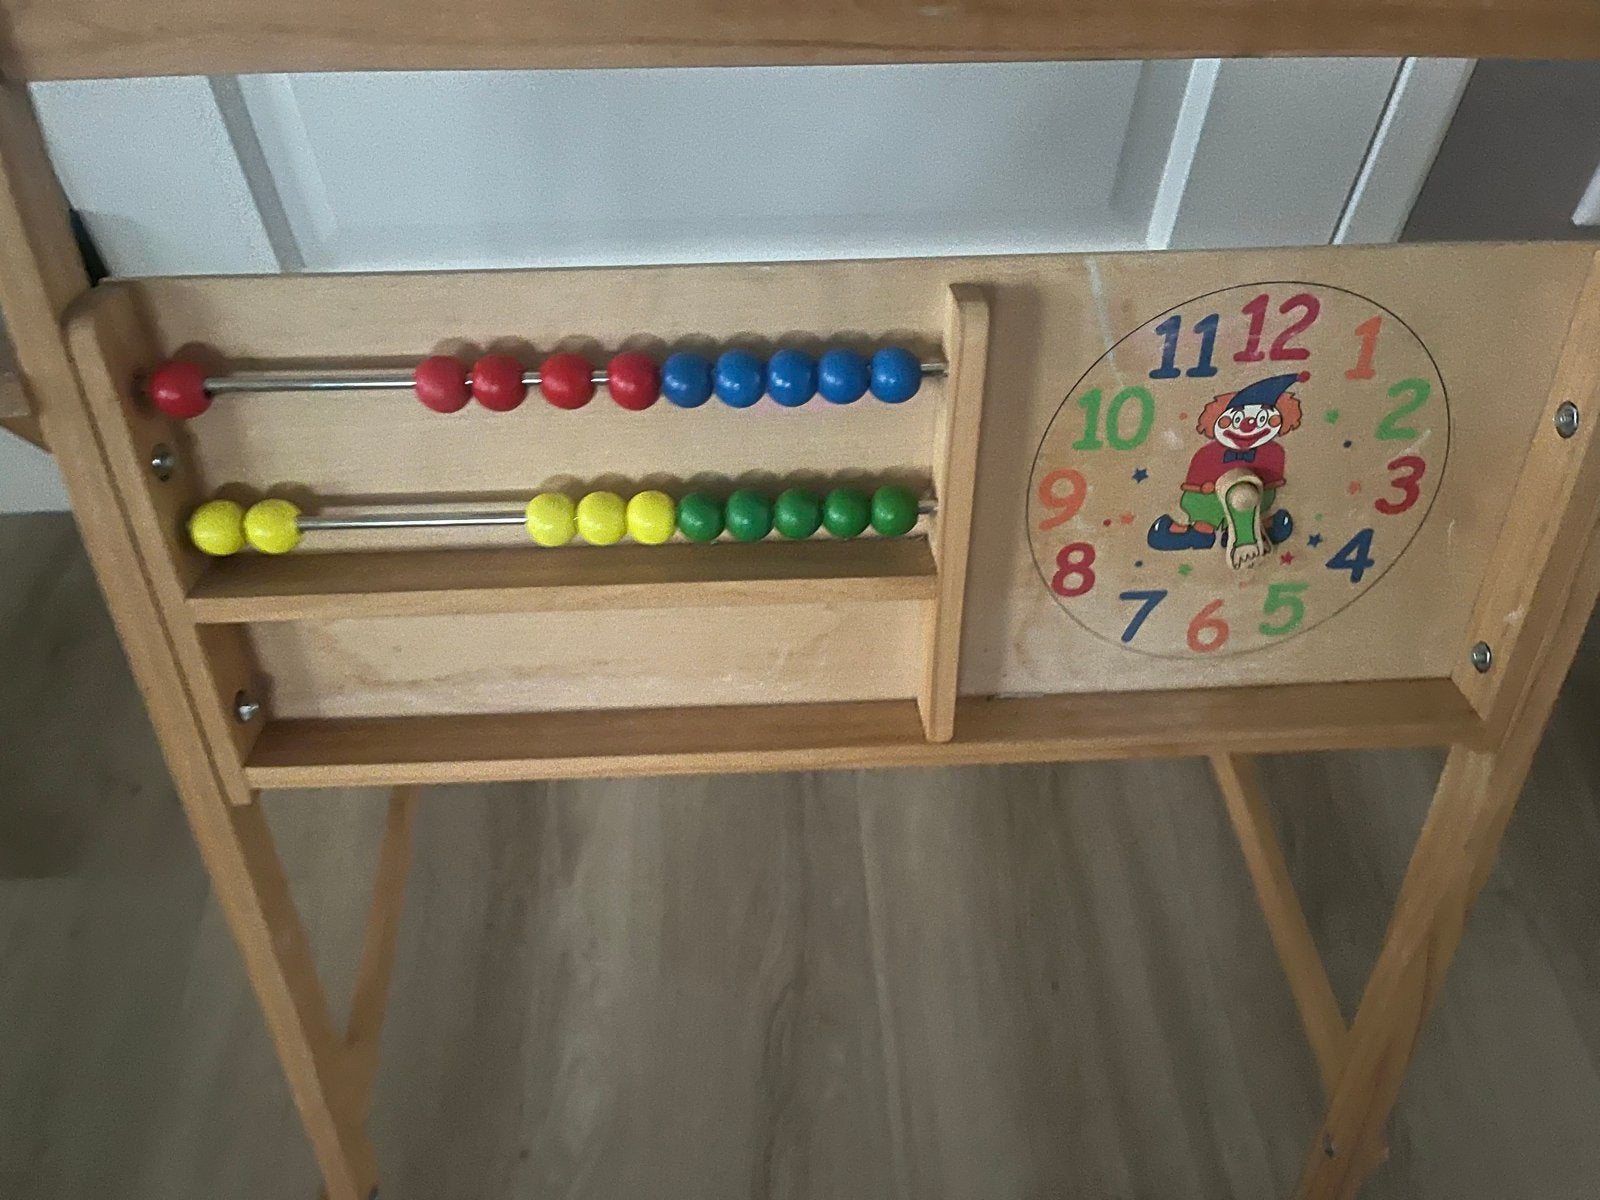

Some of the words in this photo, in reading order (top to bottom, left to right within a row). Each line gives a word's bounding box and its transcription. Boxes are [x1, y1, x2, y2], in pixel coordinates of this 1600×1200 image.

[1148, 313, 1220, 379] 11
[1232, 293, 1321, 363] 12
[1344, 316, 1383, 380] 1
[1072, 386, 1155, 451] 10
[1375, 378, 1430, 441] 2
[1038, 468, 1088, 531] 9
[1374, 455, 1426, 515] 3
[1051, 542, 1096, 597] 8
[1325, 528, 1375, 583] 4
[1118, 590, 1168, 642] 7
[1186, 599, 1229, 653] 6
[1259, 582, 1309, 636] 5
